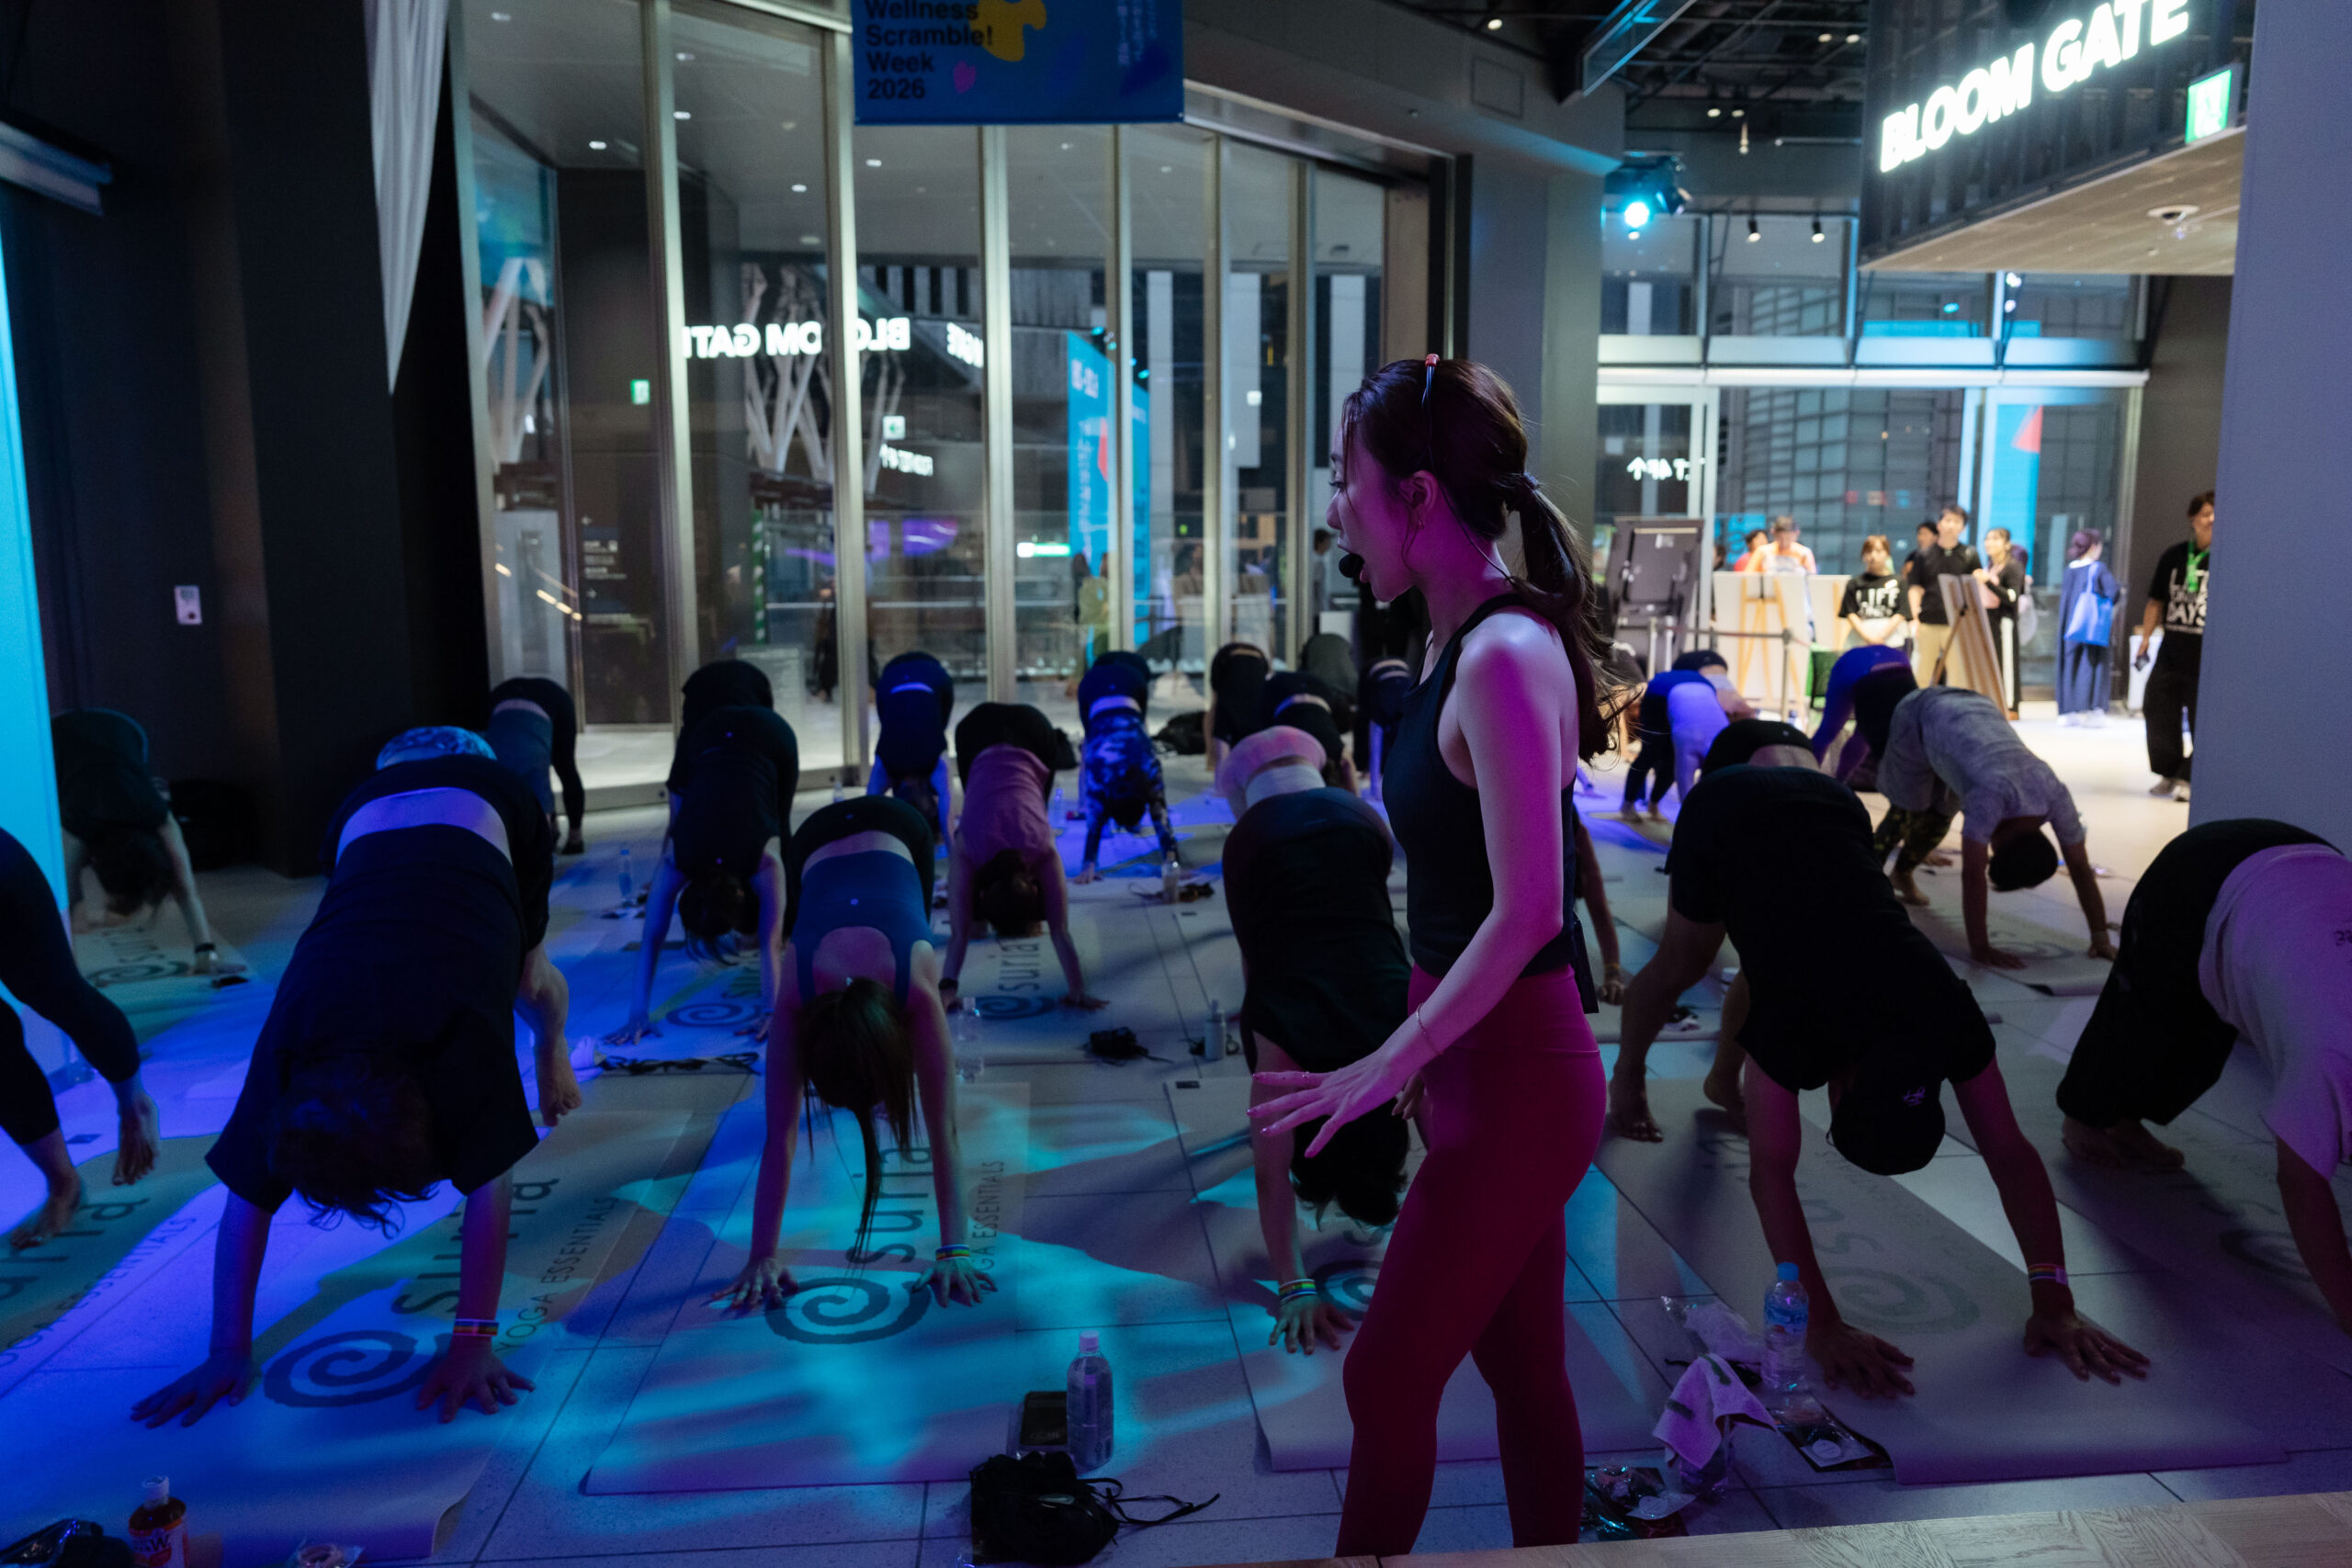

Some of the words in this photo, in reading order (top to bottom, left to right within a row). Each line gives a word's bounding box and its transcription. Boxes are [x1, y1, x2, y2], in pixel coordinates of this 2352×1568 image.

[865, 25, 993, 48] Scramble!
[867, 51, 934, 73] Week
[867, 77, 926, 100] 2026
[1880, 43, 2035, 174] BLOOM
[2041, 0, 2189, 93] GATE
[972, 1160, 1005, 1239] ESSENTIALS
[495, 1292, 559, 1352] YOGA
[540, 1196, 616, 1284] ESSENTIALS
